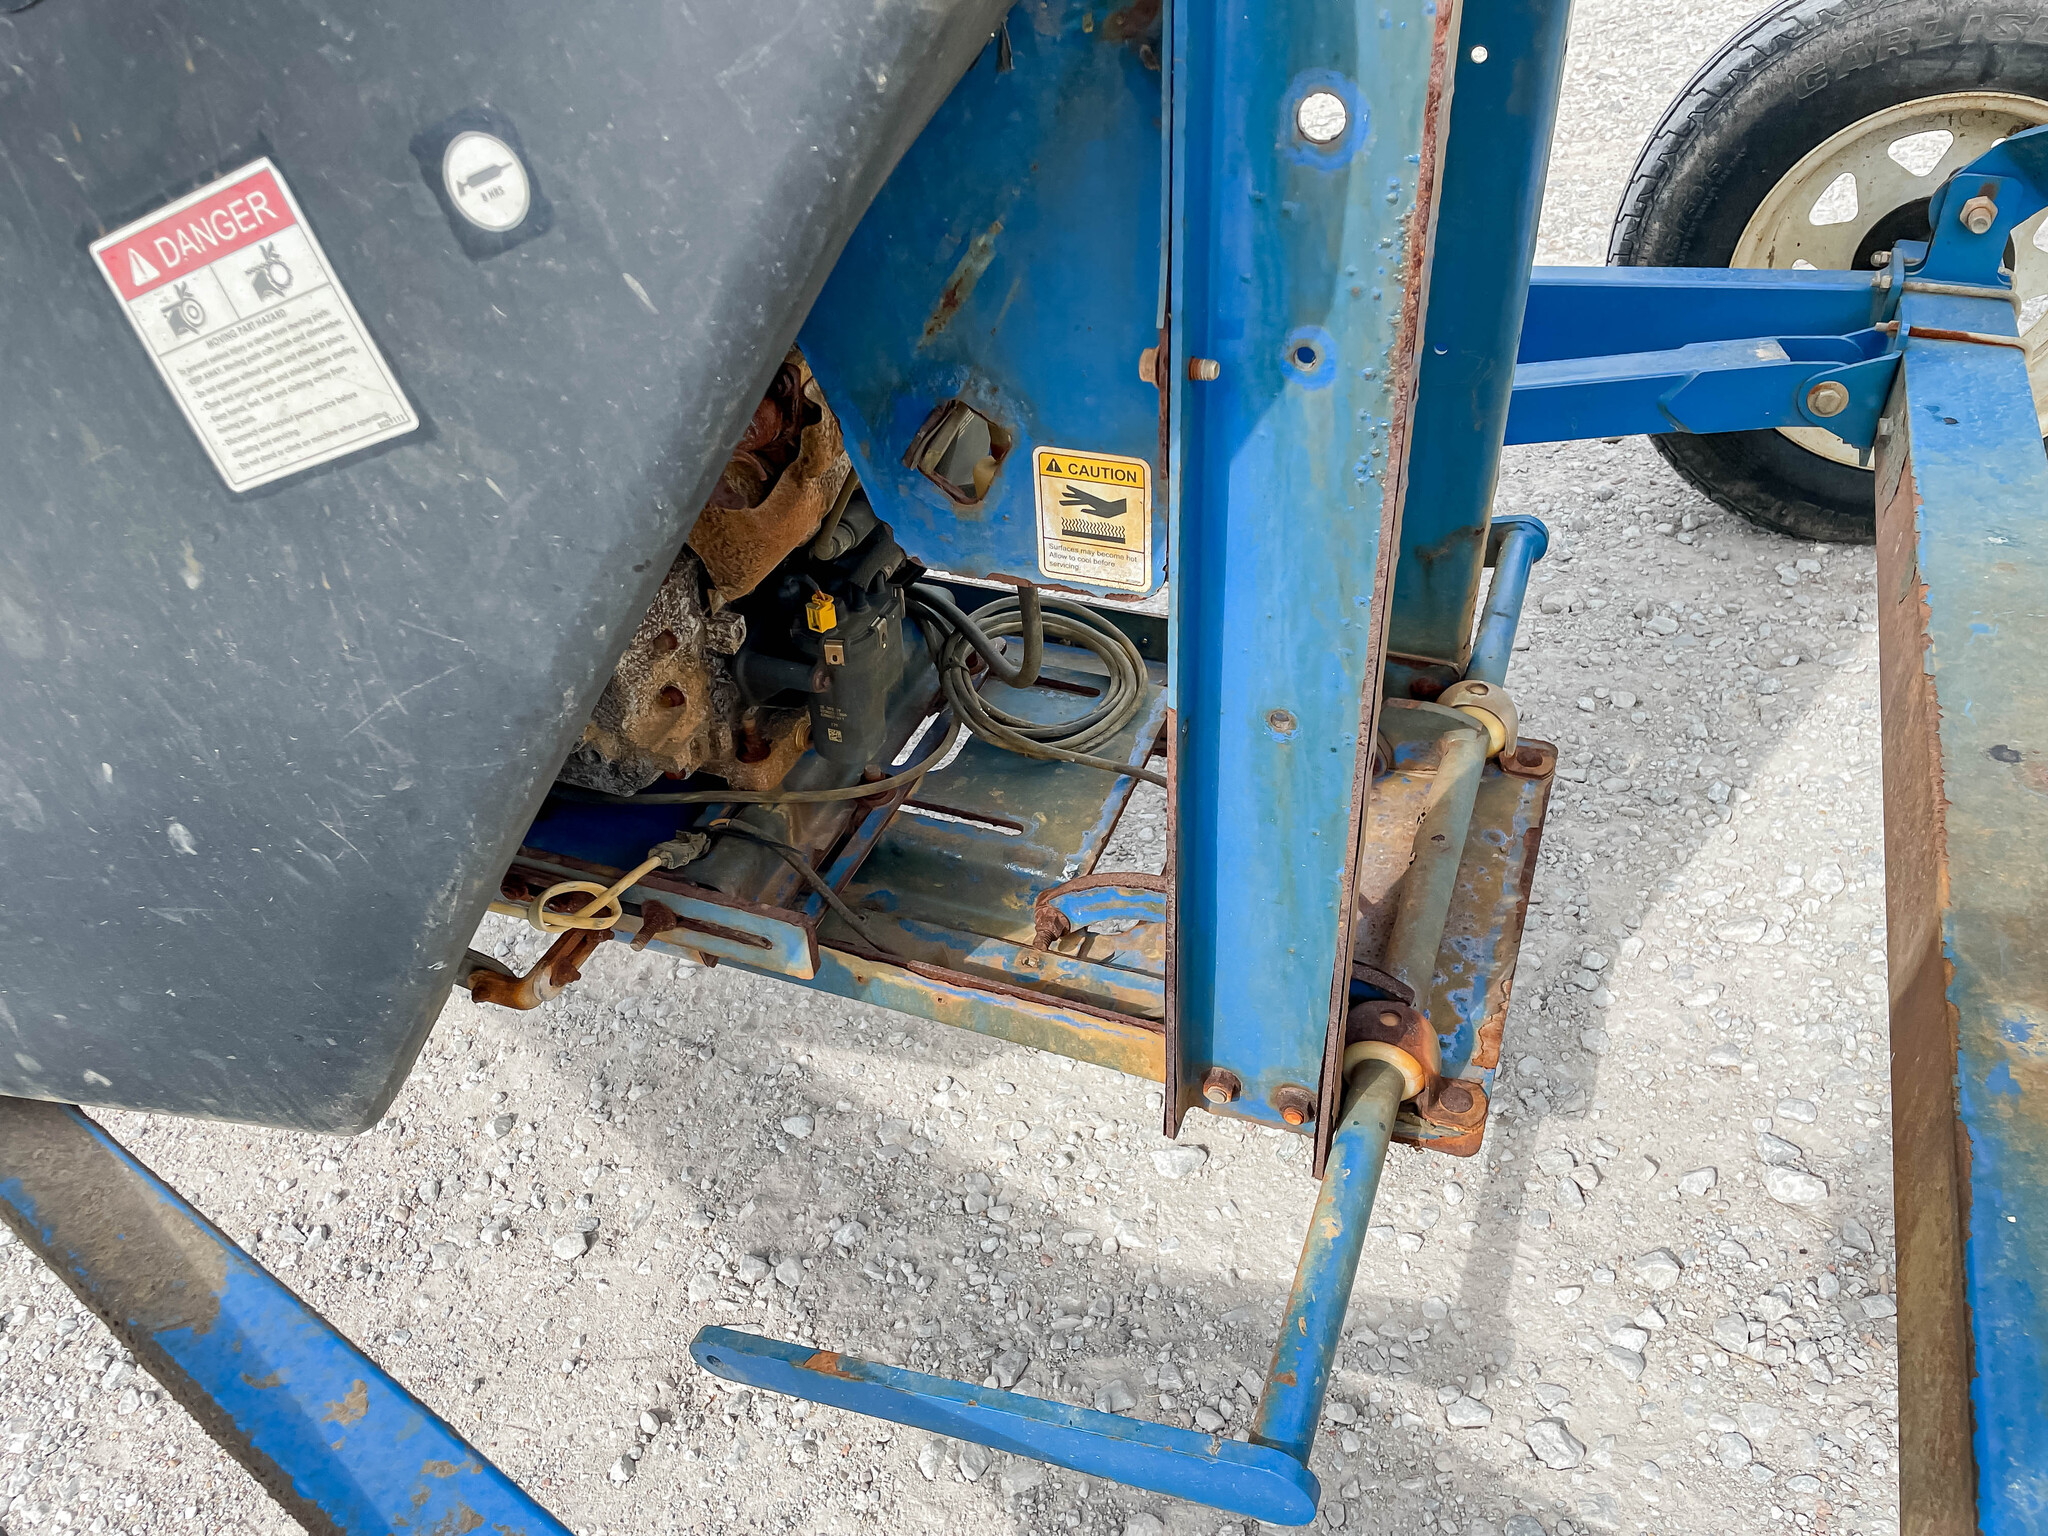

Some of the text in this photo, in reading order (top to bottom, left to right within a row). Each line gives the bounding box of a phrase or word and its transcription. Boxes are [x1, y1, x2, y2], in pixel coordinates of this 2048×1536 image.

[487, 185, 505, 200] HRS
[153, 190, 279, 268] DANGER
[205, 308, 288, 349] MOVING PART HAZARD
[1068, 463, 1136, 483] CAUTION
[1049, 543, 1078, 552] Surfaces
[1081, 548, 1095, 556] may
[1097, 551, 1124, 560] become
[1049, 551, 1067, 560] Allow
[1078, 556, 1092, 564] cool
[1094, 558, 1115, 567] before
